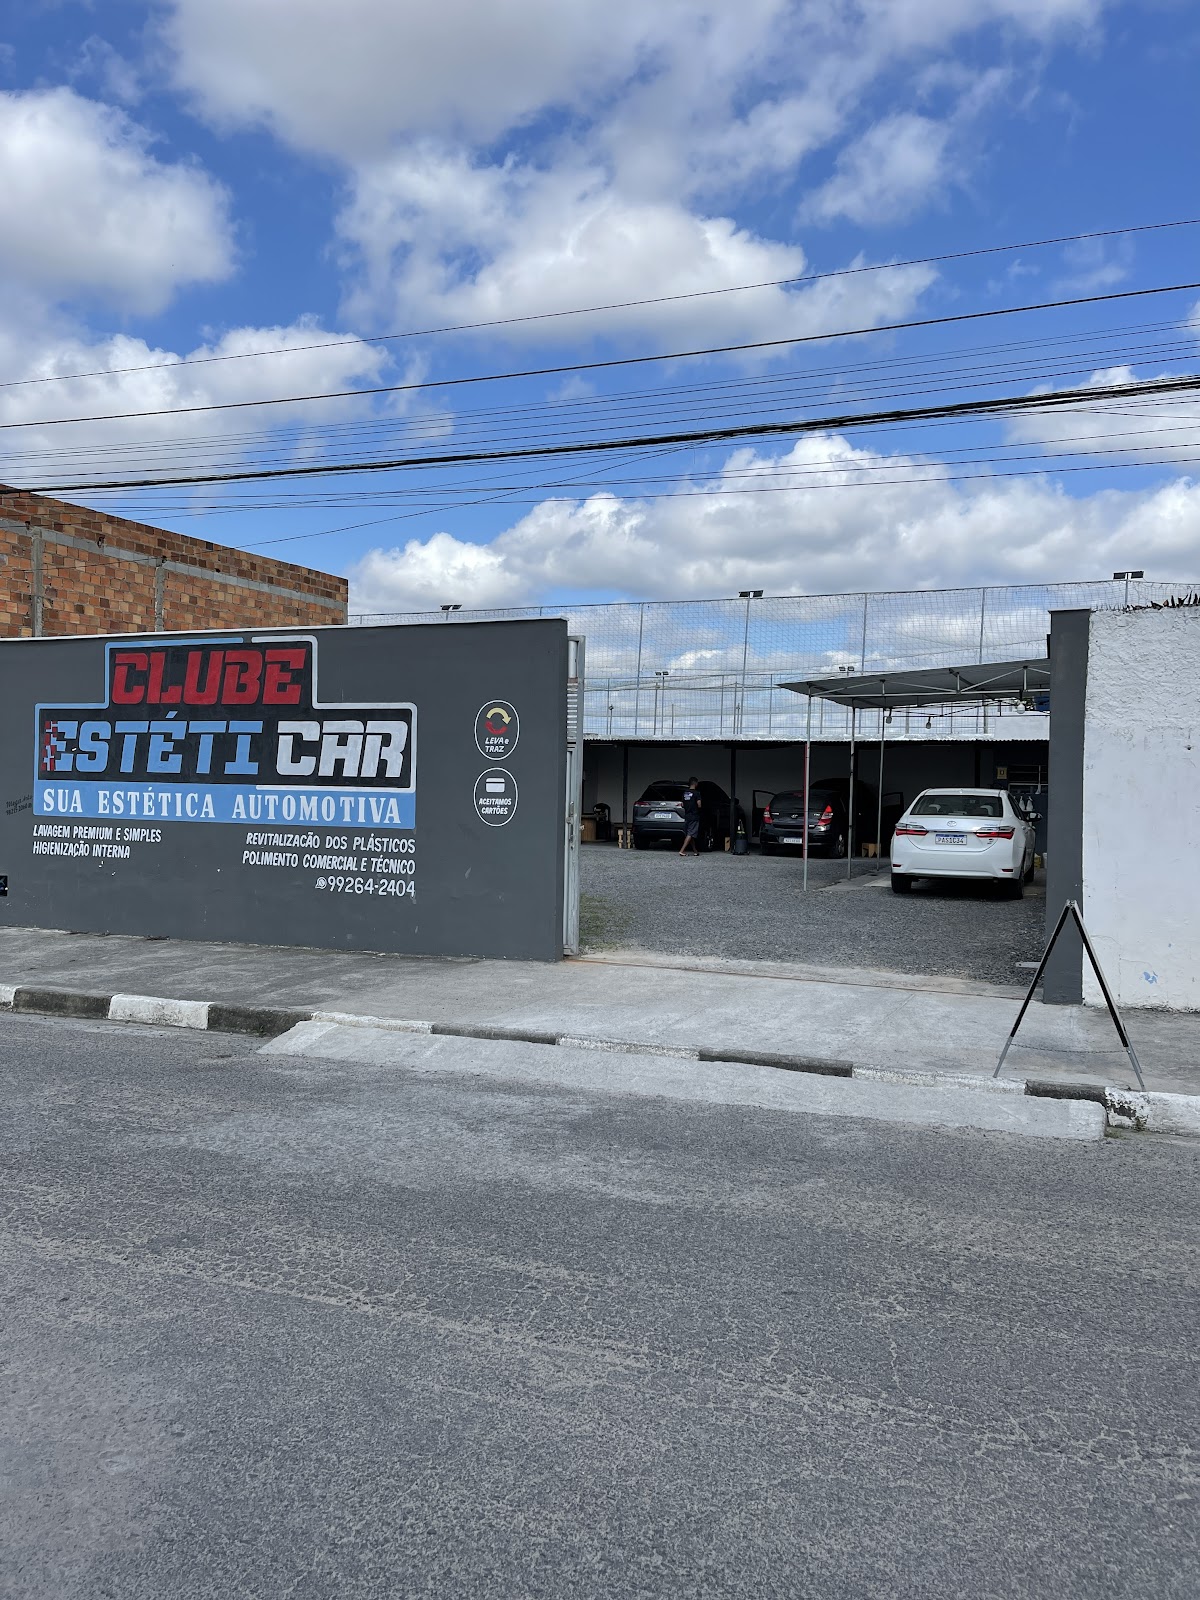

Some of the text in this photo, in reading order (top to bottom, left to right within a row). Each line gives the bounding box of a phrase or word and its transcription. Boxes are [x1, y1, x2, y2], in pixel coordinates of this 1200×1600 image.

[112, 648, 306, 705] CLUBE
[276, 720, 409, 778] CAR
[485, 745, 505, 753] TRAZ
[43, 788, 83, 813] SUA
[98, 787, 216, 819] ESTÉTICA
[232, 795, 402, 824] AUTOMOTIVA
[479, 798, 512, 806] ACEITAMOS
[481, 805, 508, 815] CARTÕES
[33, 824, 162, 843] LAVAGEM PREMIUM E SIMPLES
[325, 835, 348, 850] DOS
[353, 833, 416, 854] PLÁSTICOS
[33, 840, 131, 859] HIGIENIZAÇÃO INTERNA
[242, 850, 416, 875] POLIMENTO COMERCIAL E TÉCNICO
[327, 875, 416, 898] 99264-2404
